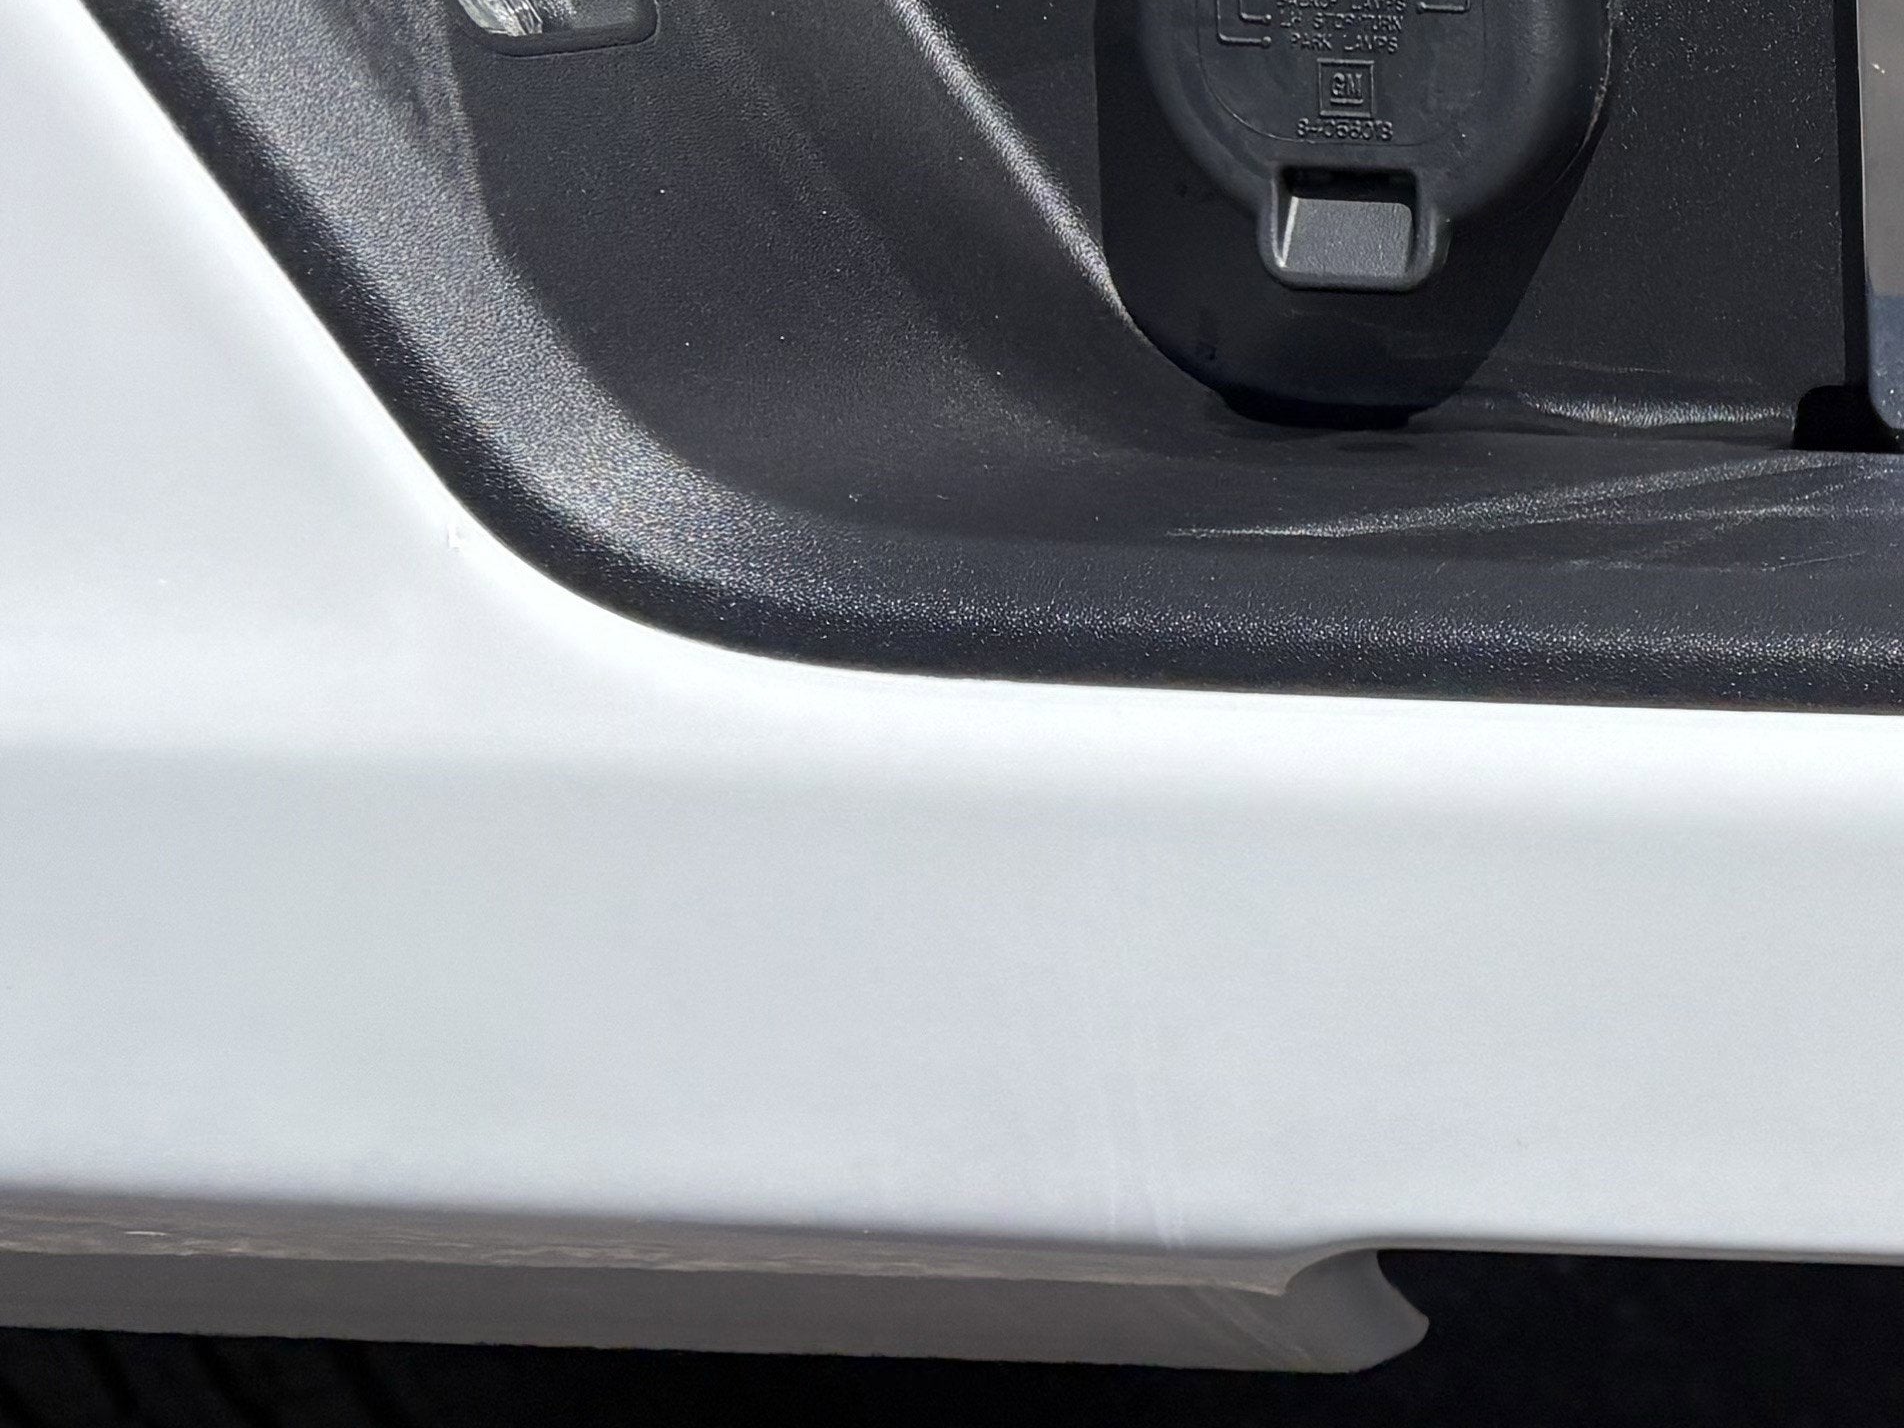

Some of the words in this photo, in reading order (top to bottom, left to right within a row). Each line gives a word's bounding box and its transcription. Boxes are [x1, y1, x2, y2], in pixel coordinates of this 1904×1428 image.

[1291, 31, 1333, 51] PARK
[1343, 34, 1399, 54] LAMPS
[1331, 72, 1363, 97] GM
